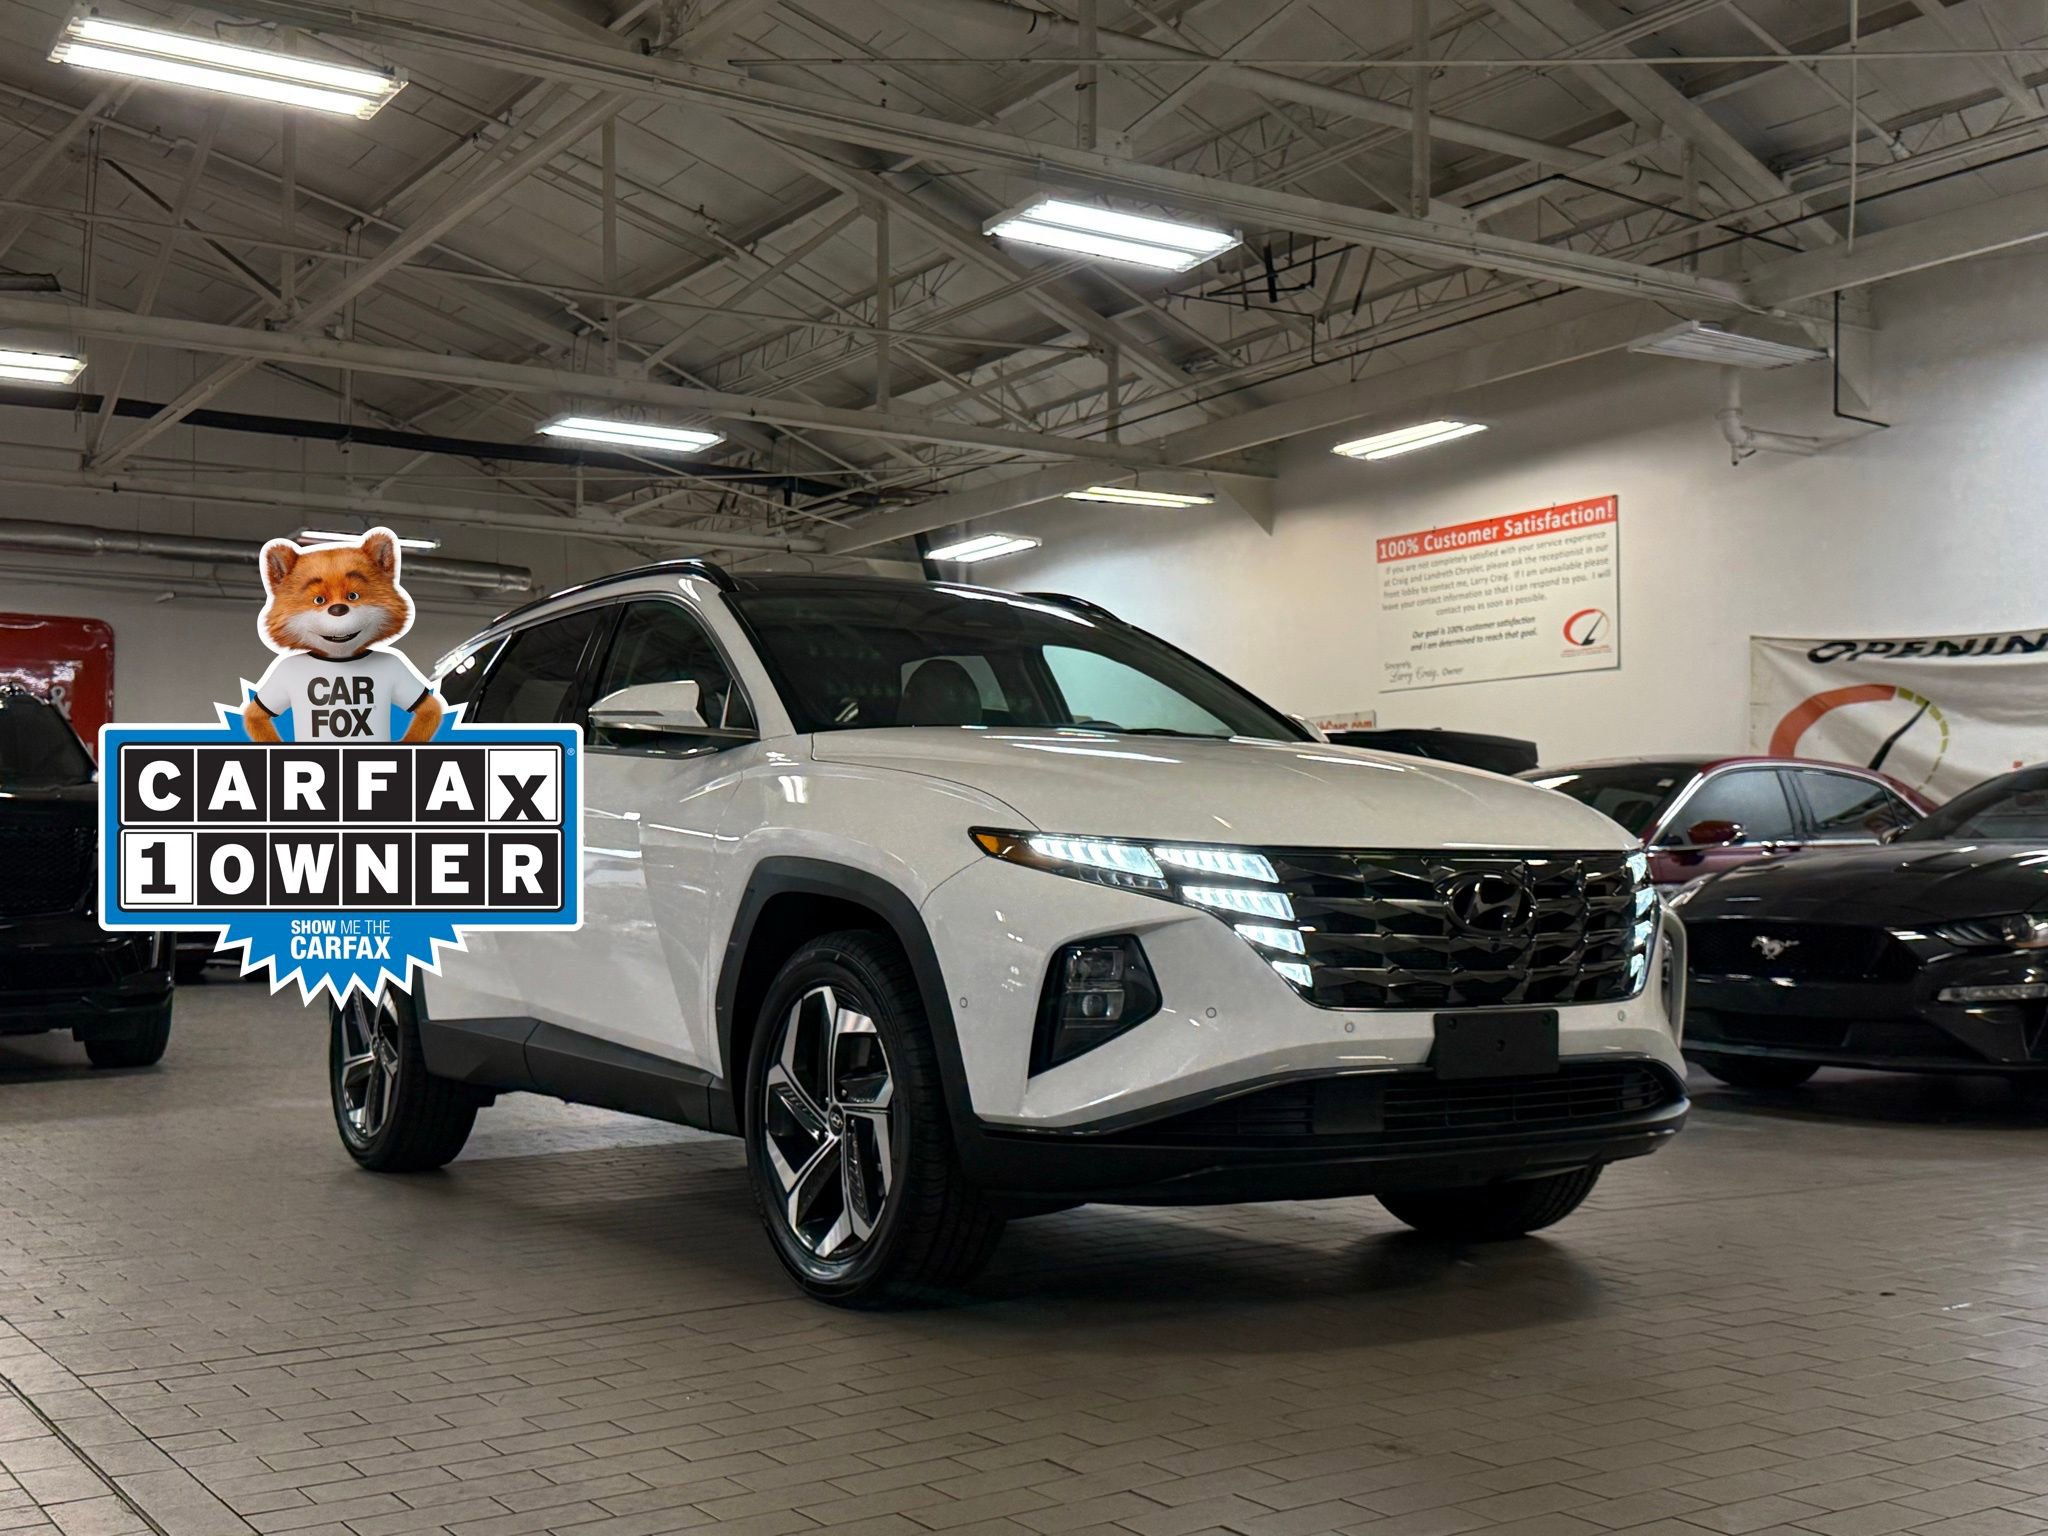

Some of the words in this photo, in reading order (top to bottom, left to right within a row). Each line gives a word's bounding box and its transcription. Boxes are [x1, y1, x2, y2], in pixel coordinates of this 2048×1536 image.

[1379, 538, 1419, 559] 100%
[1424, 525, 1500, 551] Customer
[1504, 501, 1614, 536] Satisfaction!
